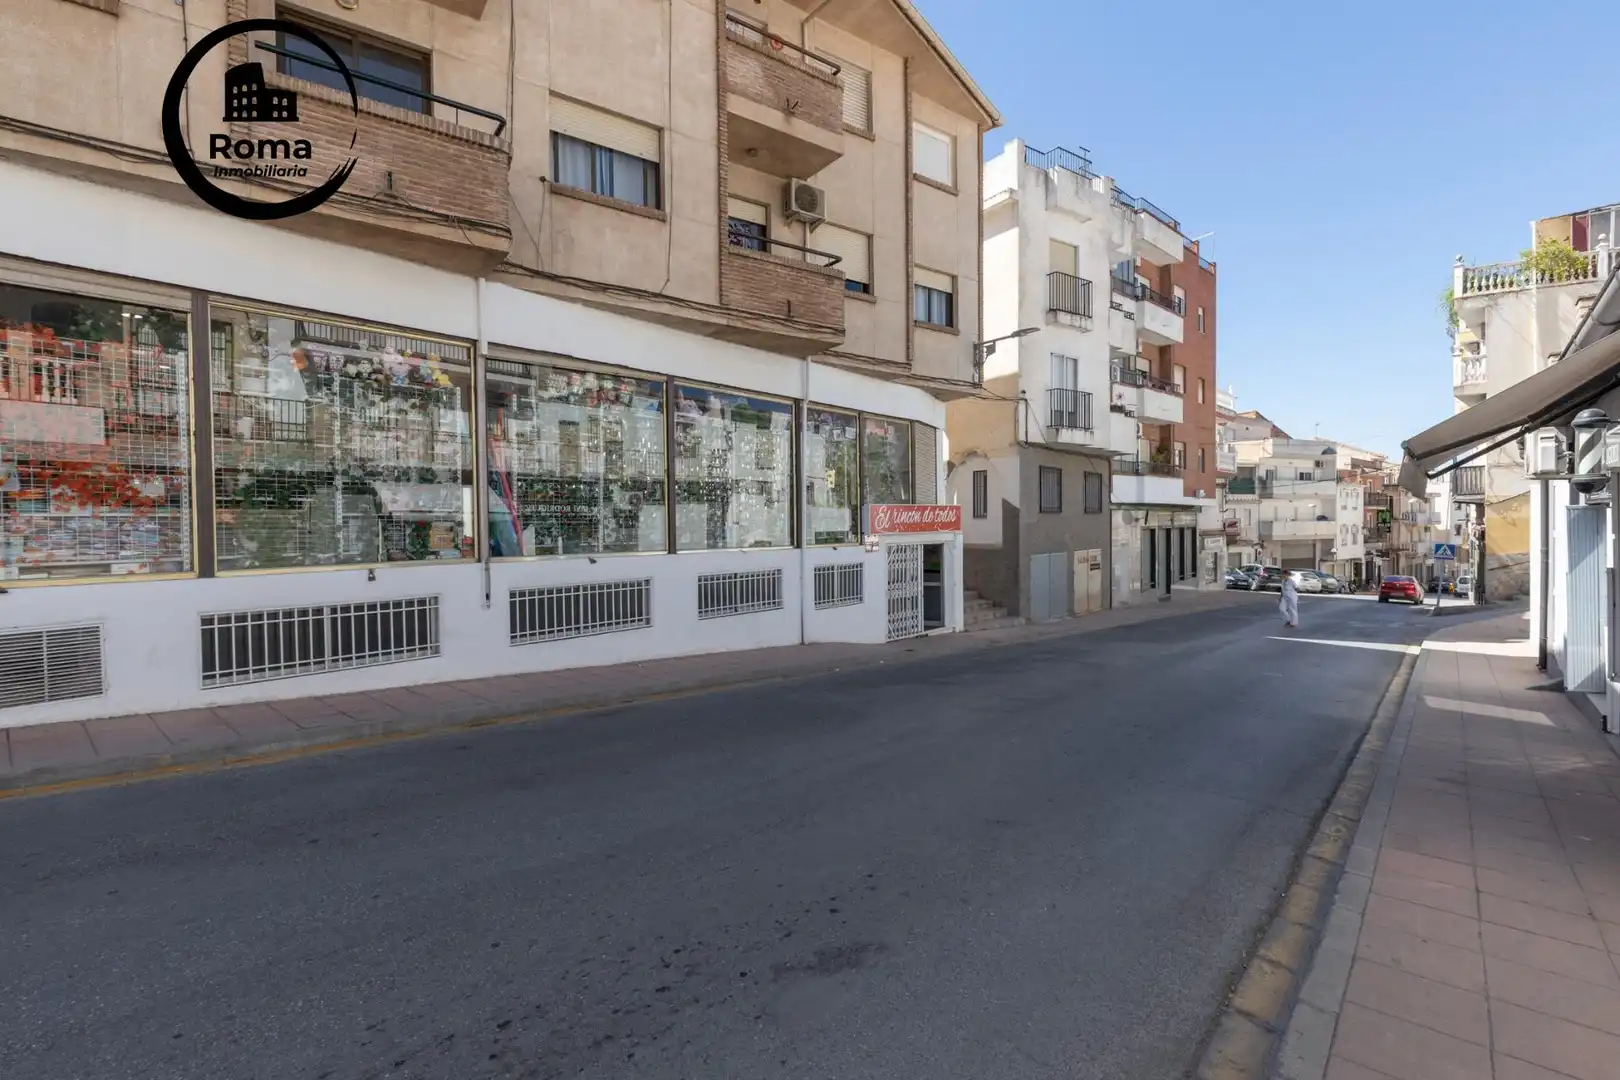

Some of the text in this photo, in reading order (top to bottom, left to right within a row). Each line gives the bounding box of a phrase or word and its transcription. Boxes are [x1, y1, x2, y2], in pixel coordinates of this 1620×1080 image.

[874, 505, 957, 530] El rincón de todos
